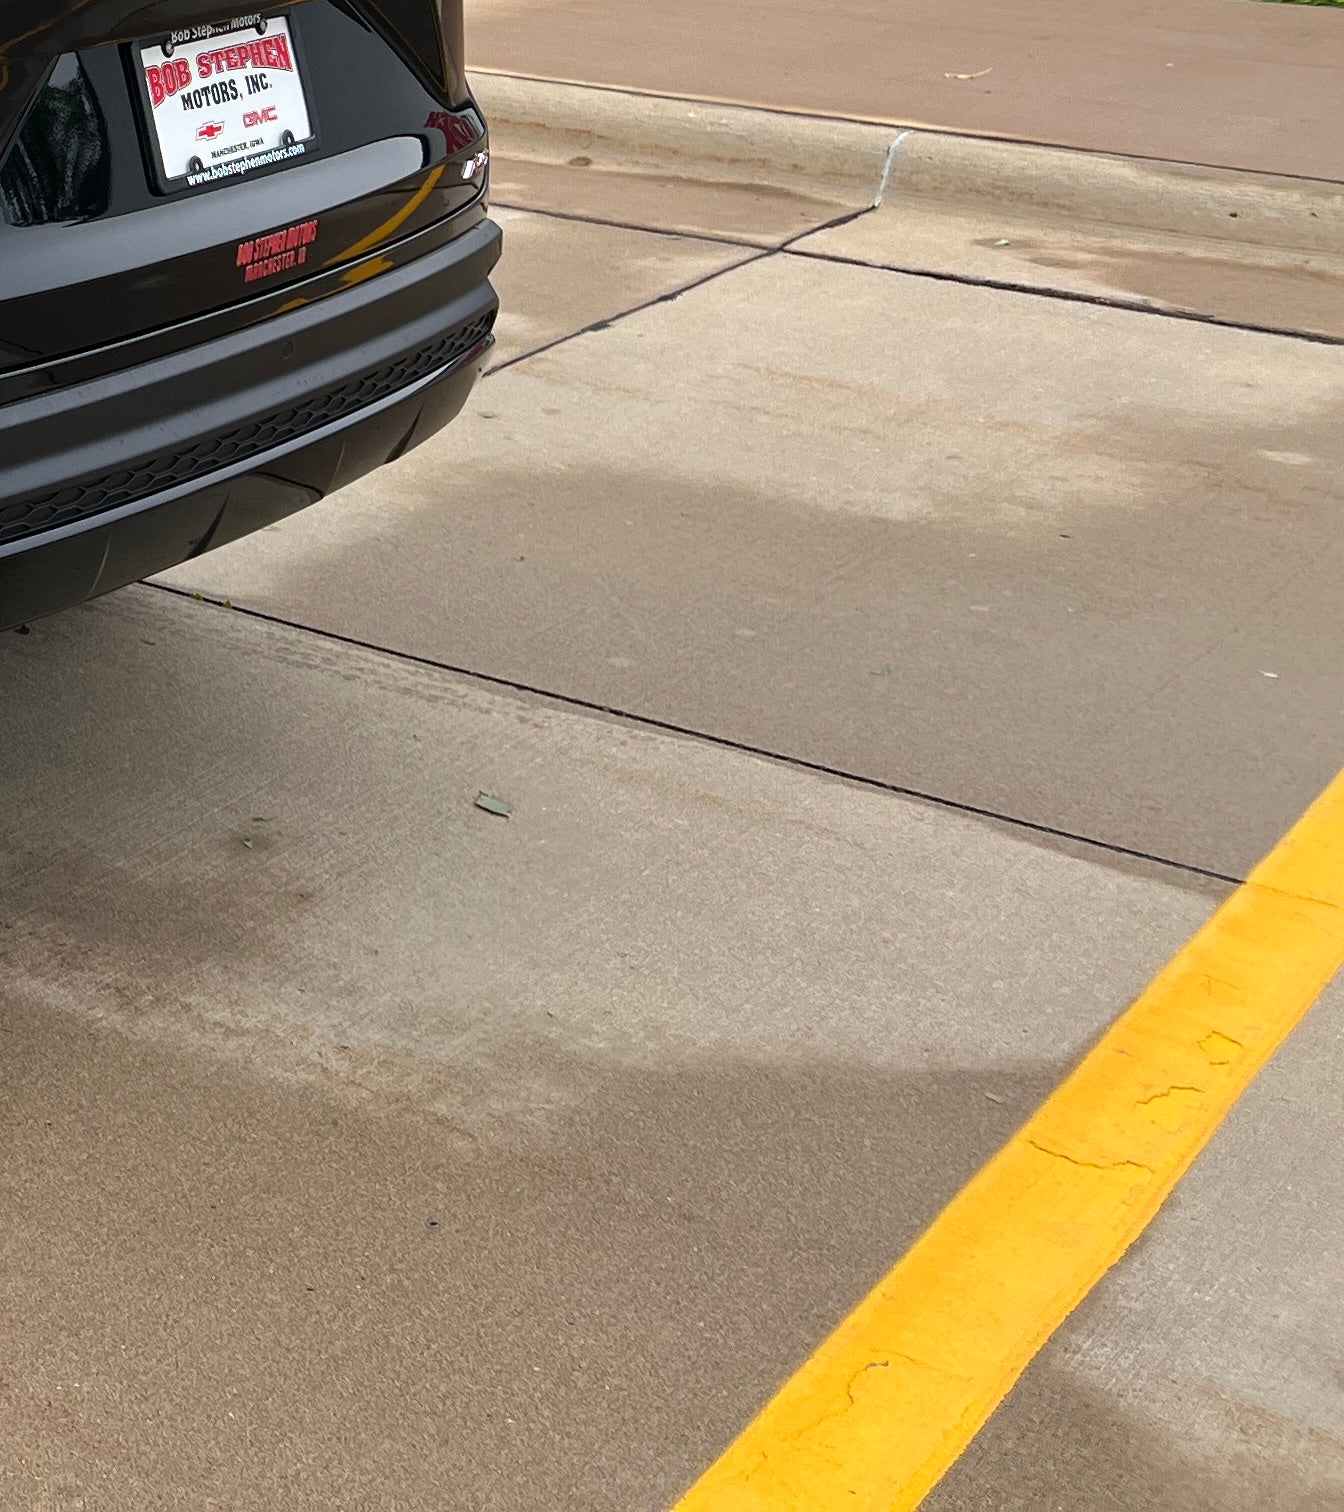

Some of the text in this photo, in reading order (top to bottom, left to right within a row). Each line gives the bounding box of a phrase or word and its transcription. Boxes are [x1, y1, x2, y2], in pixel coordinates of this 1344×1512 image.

[231, 13, 261, 29] Motors
[146, 33, 294, 109] BOB STEPHEN
[181, 72, 273, 111] MOTORS, INC.
[243, 105, 278, 128] GMC
[187, 143, 305, 186] www.bobstephenmotors.com
